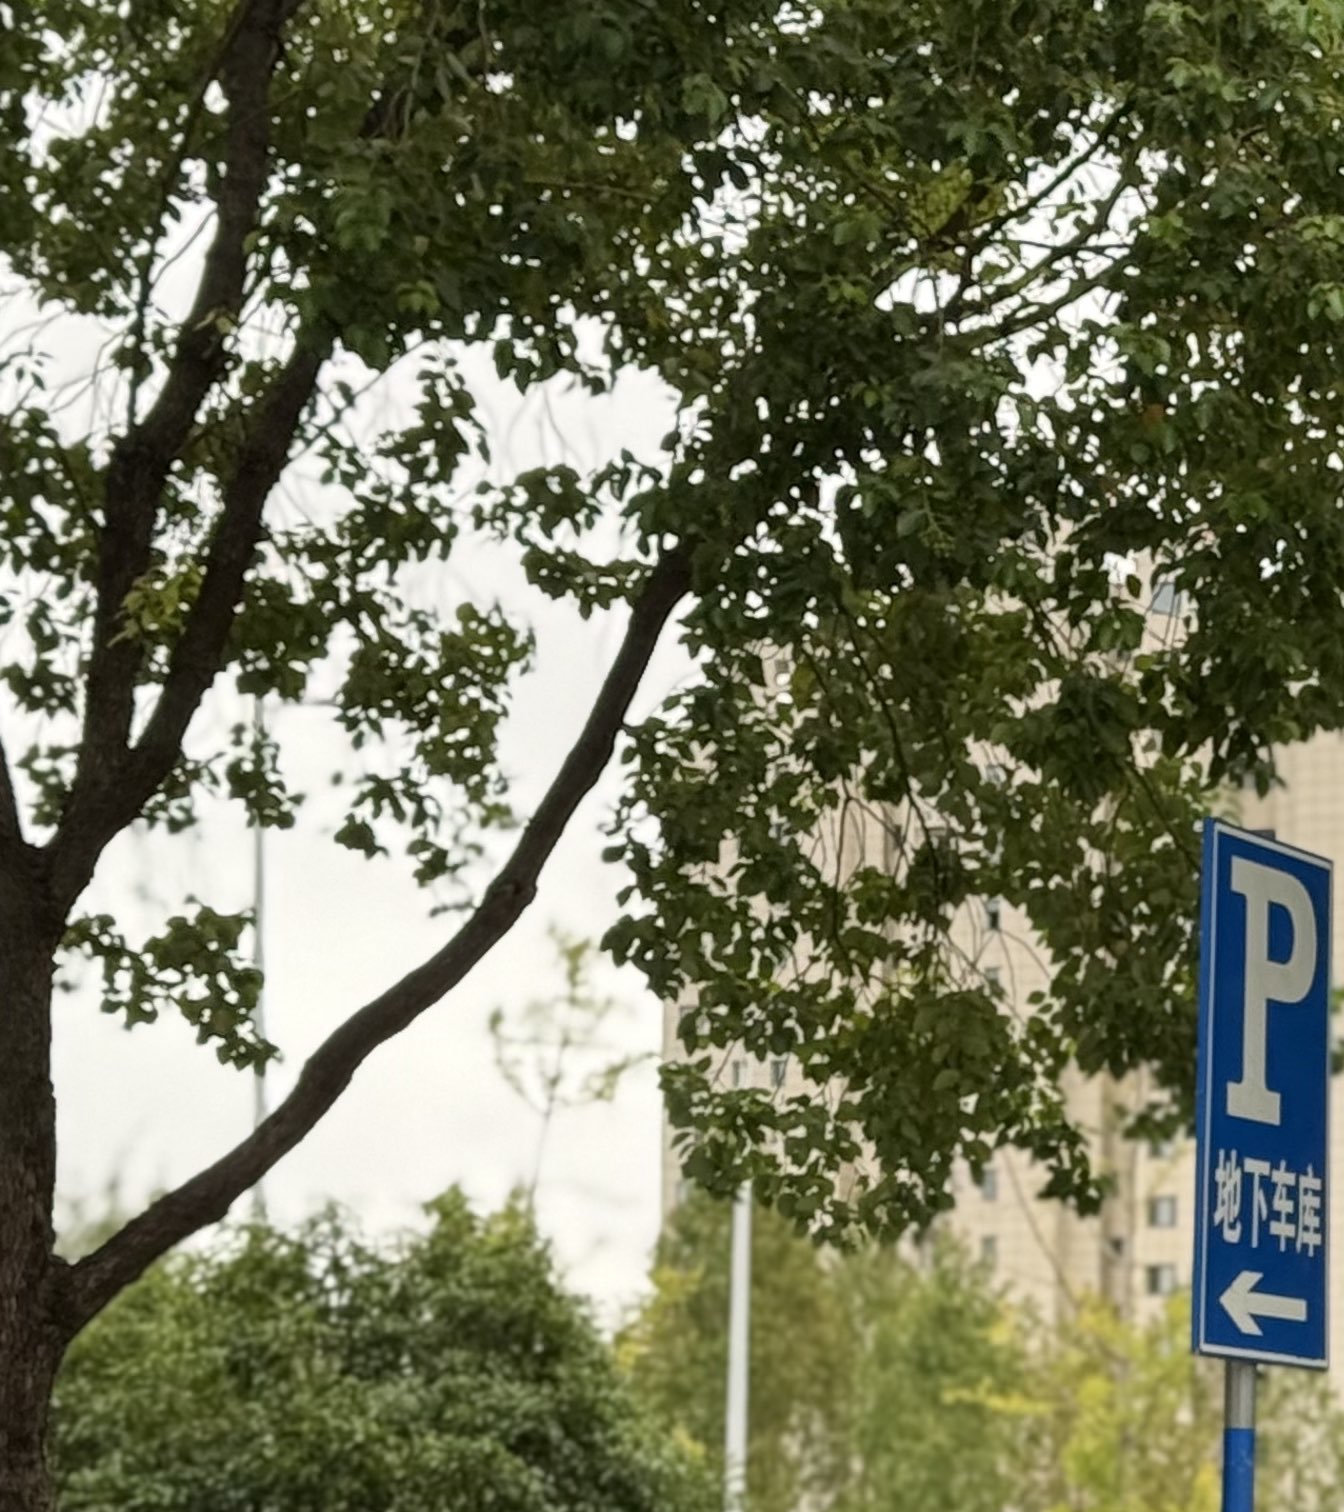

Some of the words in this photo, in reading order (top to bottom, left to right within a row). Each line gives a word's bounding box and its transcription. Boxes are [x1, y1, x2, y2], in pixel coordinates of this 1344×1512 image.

[1226, 854, 1317, 1126] P
[1214, 1148, 1322, 1257] 地下车库
